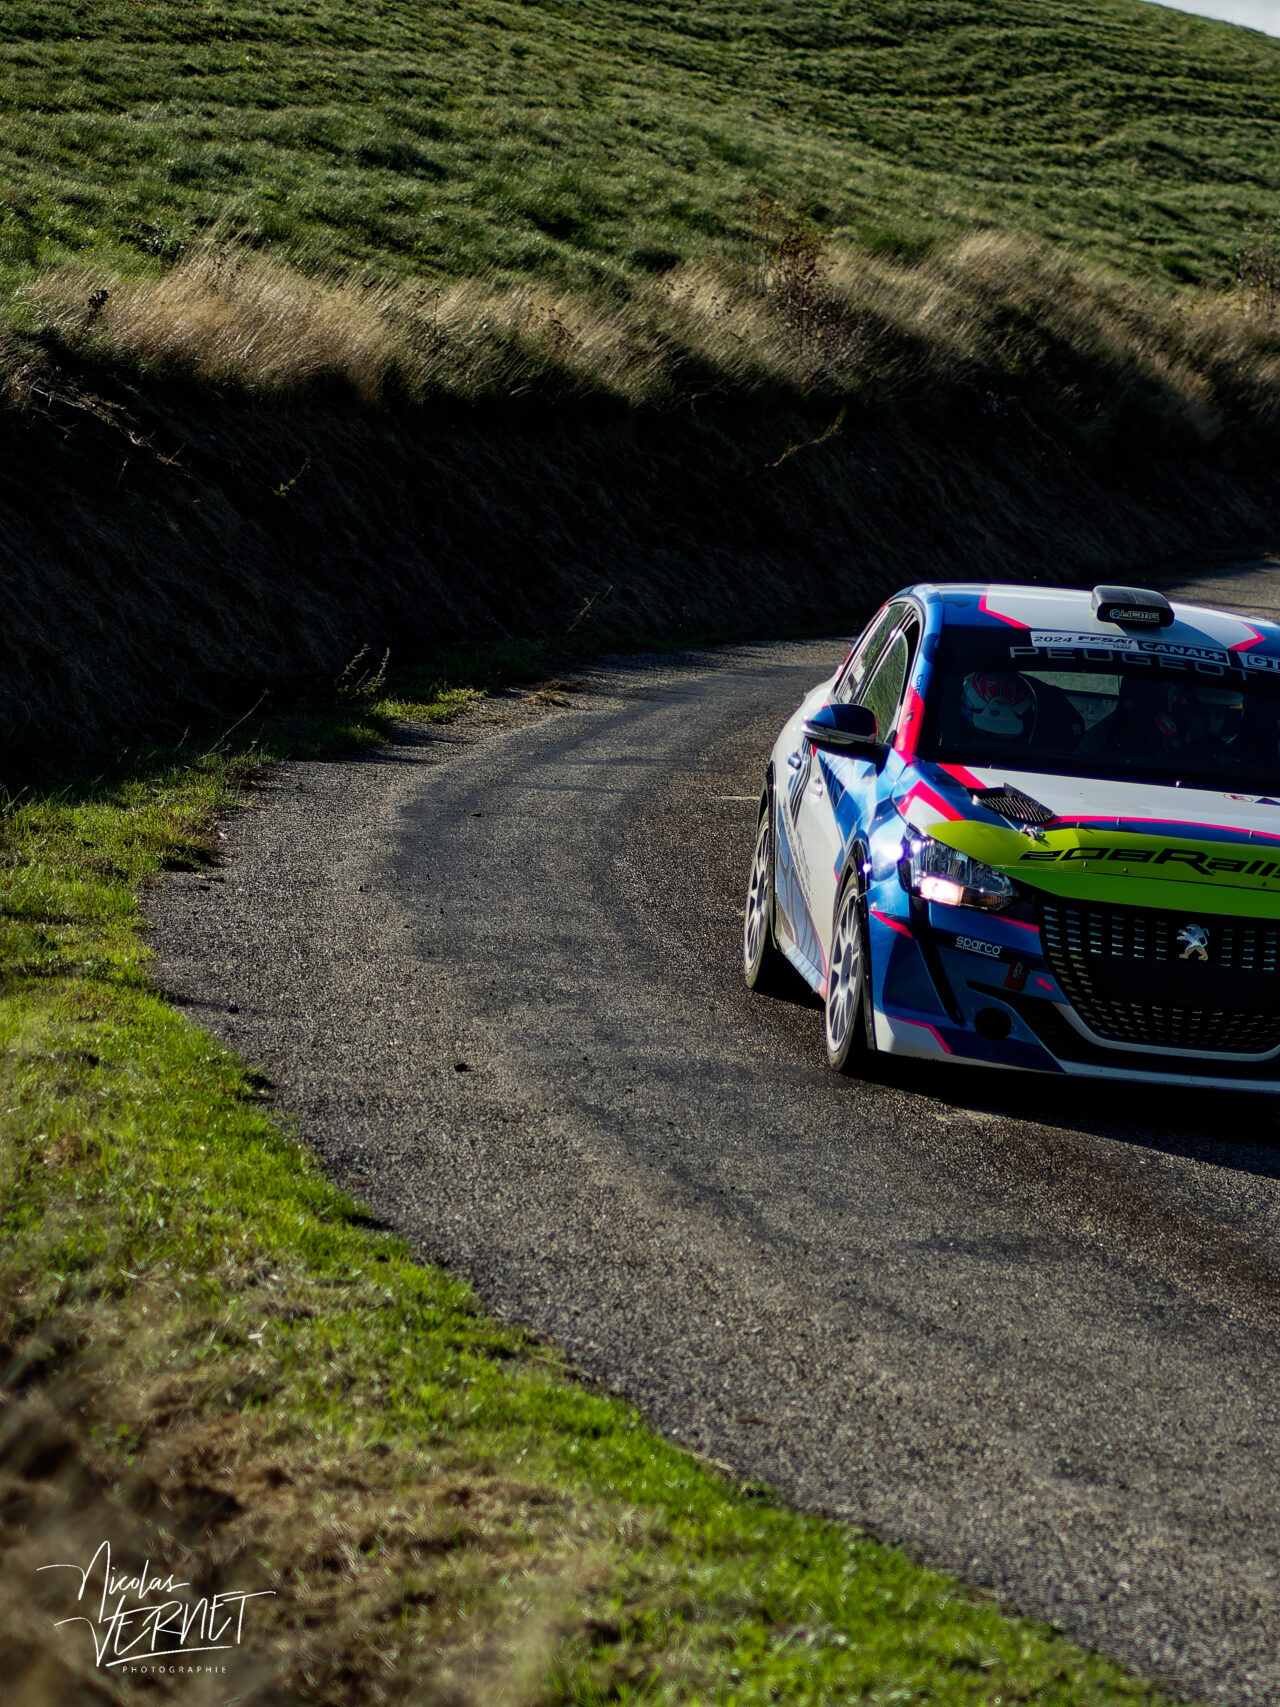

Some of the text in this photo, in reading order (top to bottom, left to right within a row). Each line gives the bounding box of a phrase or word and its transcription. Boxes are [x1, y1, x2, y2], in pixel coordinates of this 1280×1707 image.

[1033, 635, 1073, 643] 2024
[1141, 642, 1225, 661] CANAL+
[1009, 646, 1257, 681] PEUGEOT
[955, 935, 1001, 957] sparco
